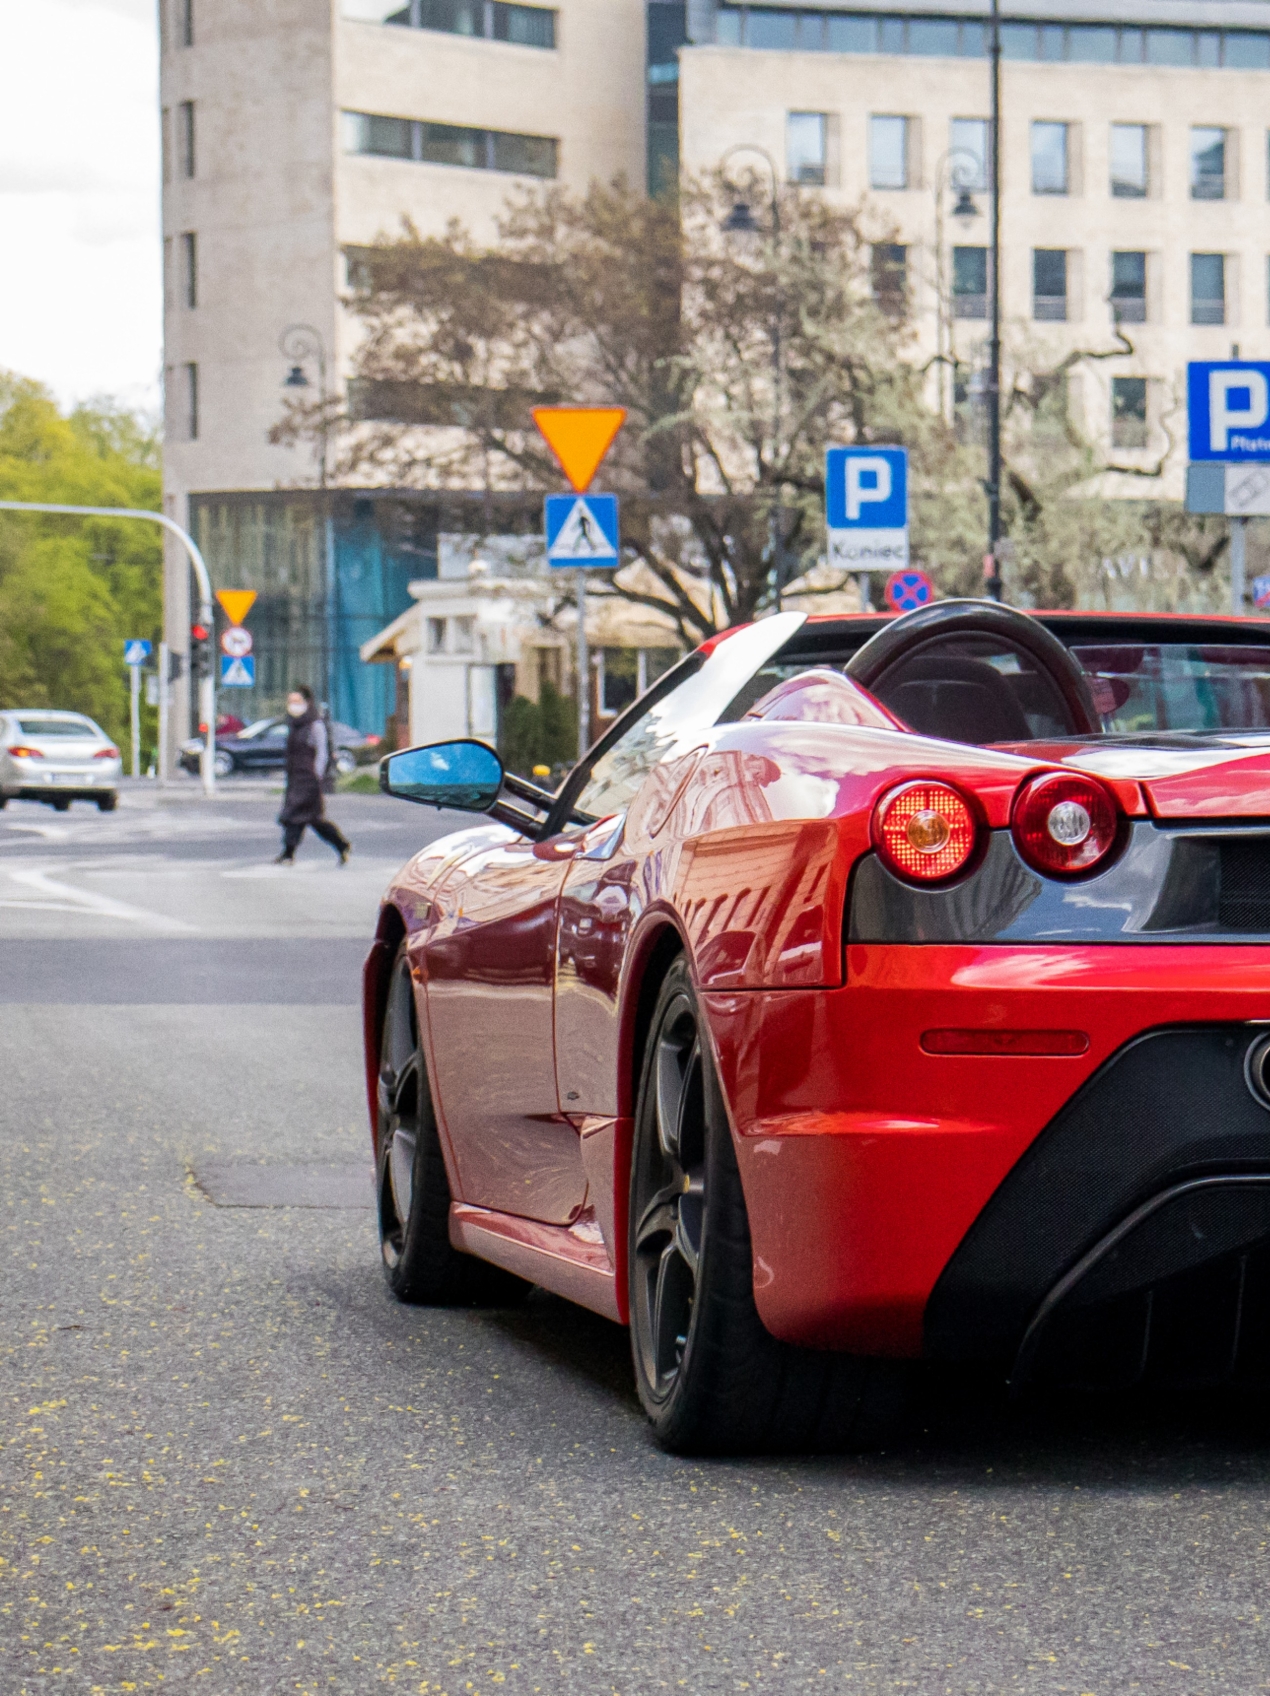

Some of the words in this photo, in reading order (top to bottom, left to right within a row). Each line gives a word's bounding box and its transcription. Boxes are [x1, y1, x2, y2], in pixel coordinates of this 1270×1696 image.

[1209, 369, 1269, 452] P
[845, 457, 892, 520] P
[832, 541, 904, 560] Koniec
